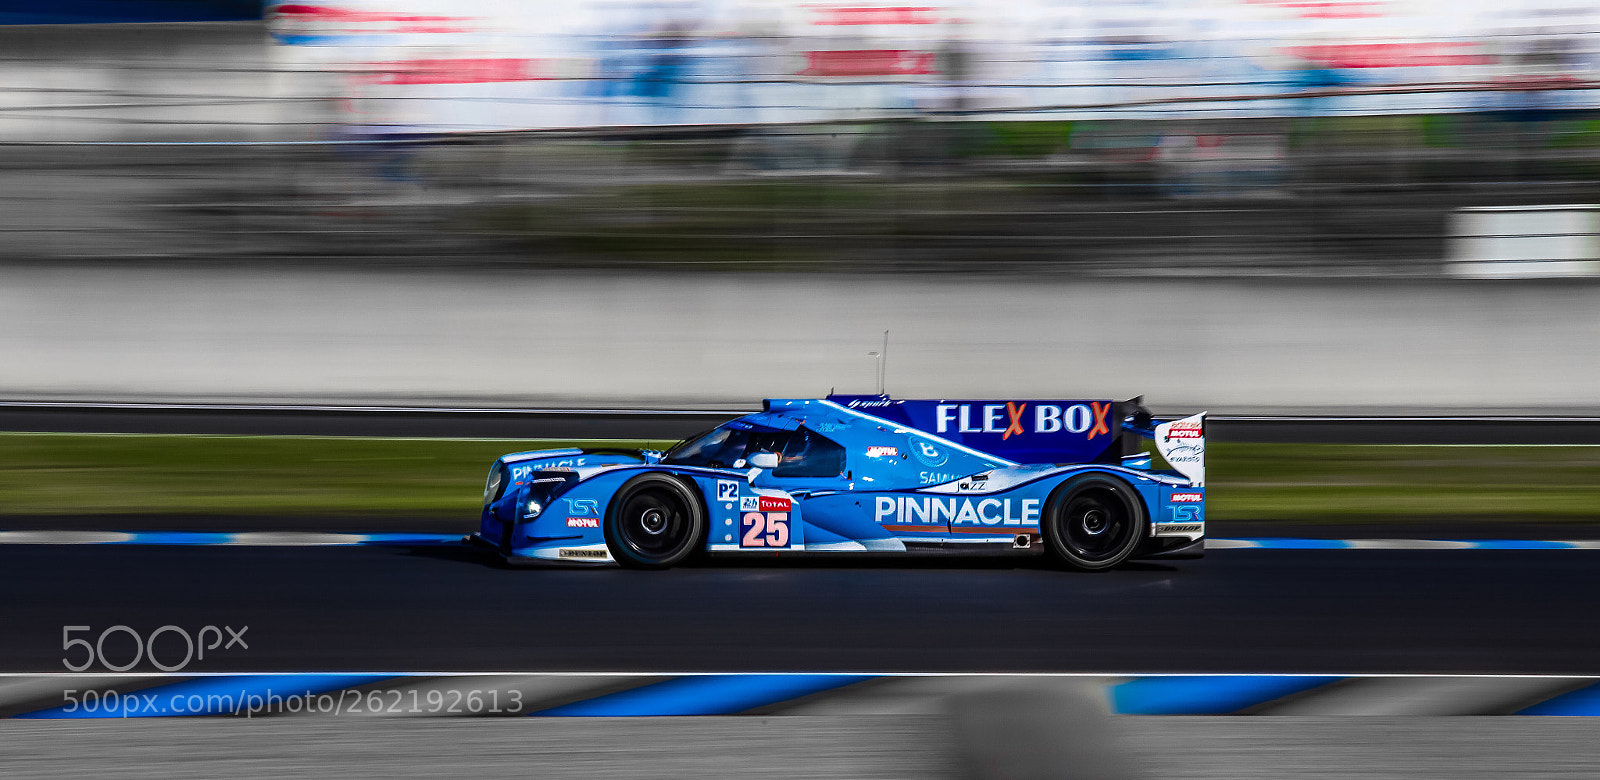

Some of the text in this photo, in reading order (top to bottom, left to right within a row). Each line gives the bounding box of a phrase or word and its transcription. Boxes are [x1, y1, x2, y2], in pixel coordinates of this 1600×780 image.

[936, 401, 1112, 440] FLEX BOX
[1170, 429, 1200, 437] MOTUL
[718, 483, 738, 498] P2
[1172, 494, 1201, 502] MOTUL
[875, 497, 1040, 526] PINNACLE
[567, 518, 599, 527] MOTUL
[742, 512, 789, 547] 25
